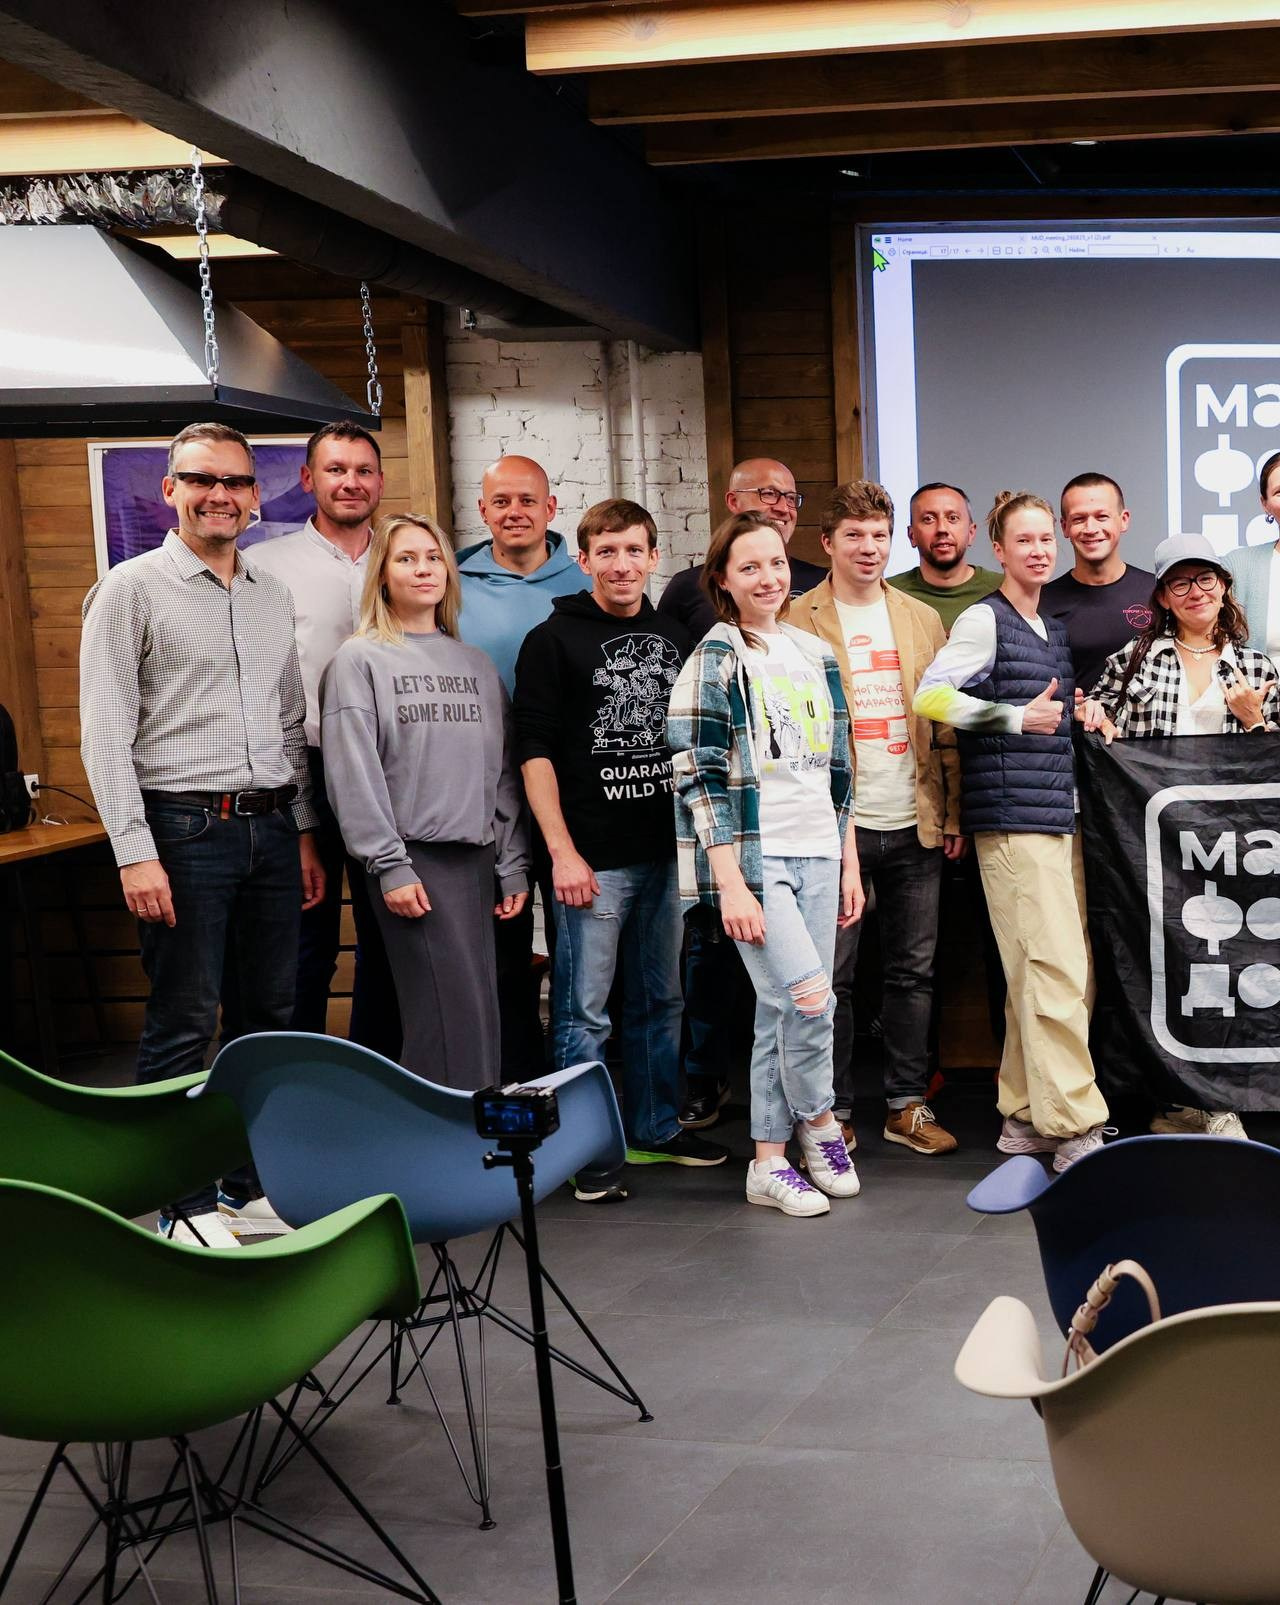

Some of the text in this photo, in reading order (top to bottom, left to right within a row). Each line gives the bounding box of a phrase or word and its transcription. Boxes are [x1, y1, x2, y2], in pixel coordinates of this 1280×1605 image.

[392, 674, 480, 696] LET'S BREAK
[397, 703, 440, 725] SOME
[603, 782, 656, 800] WILD
